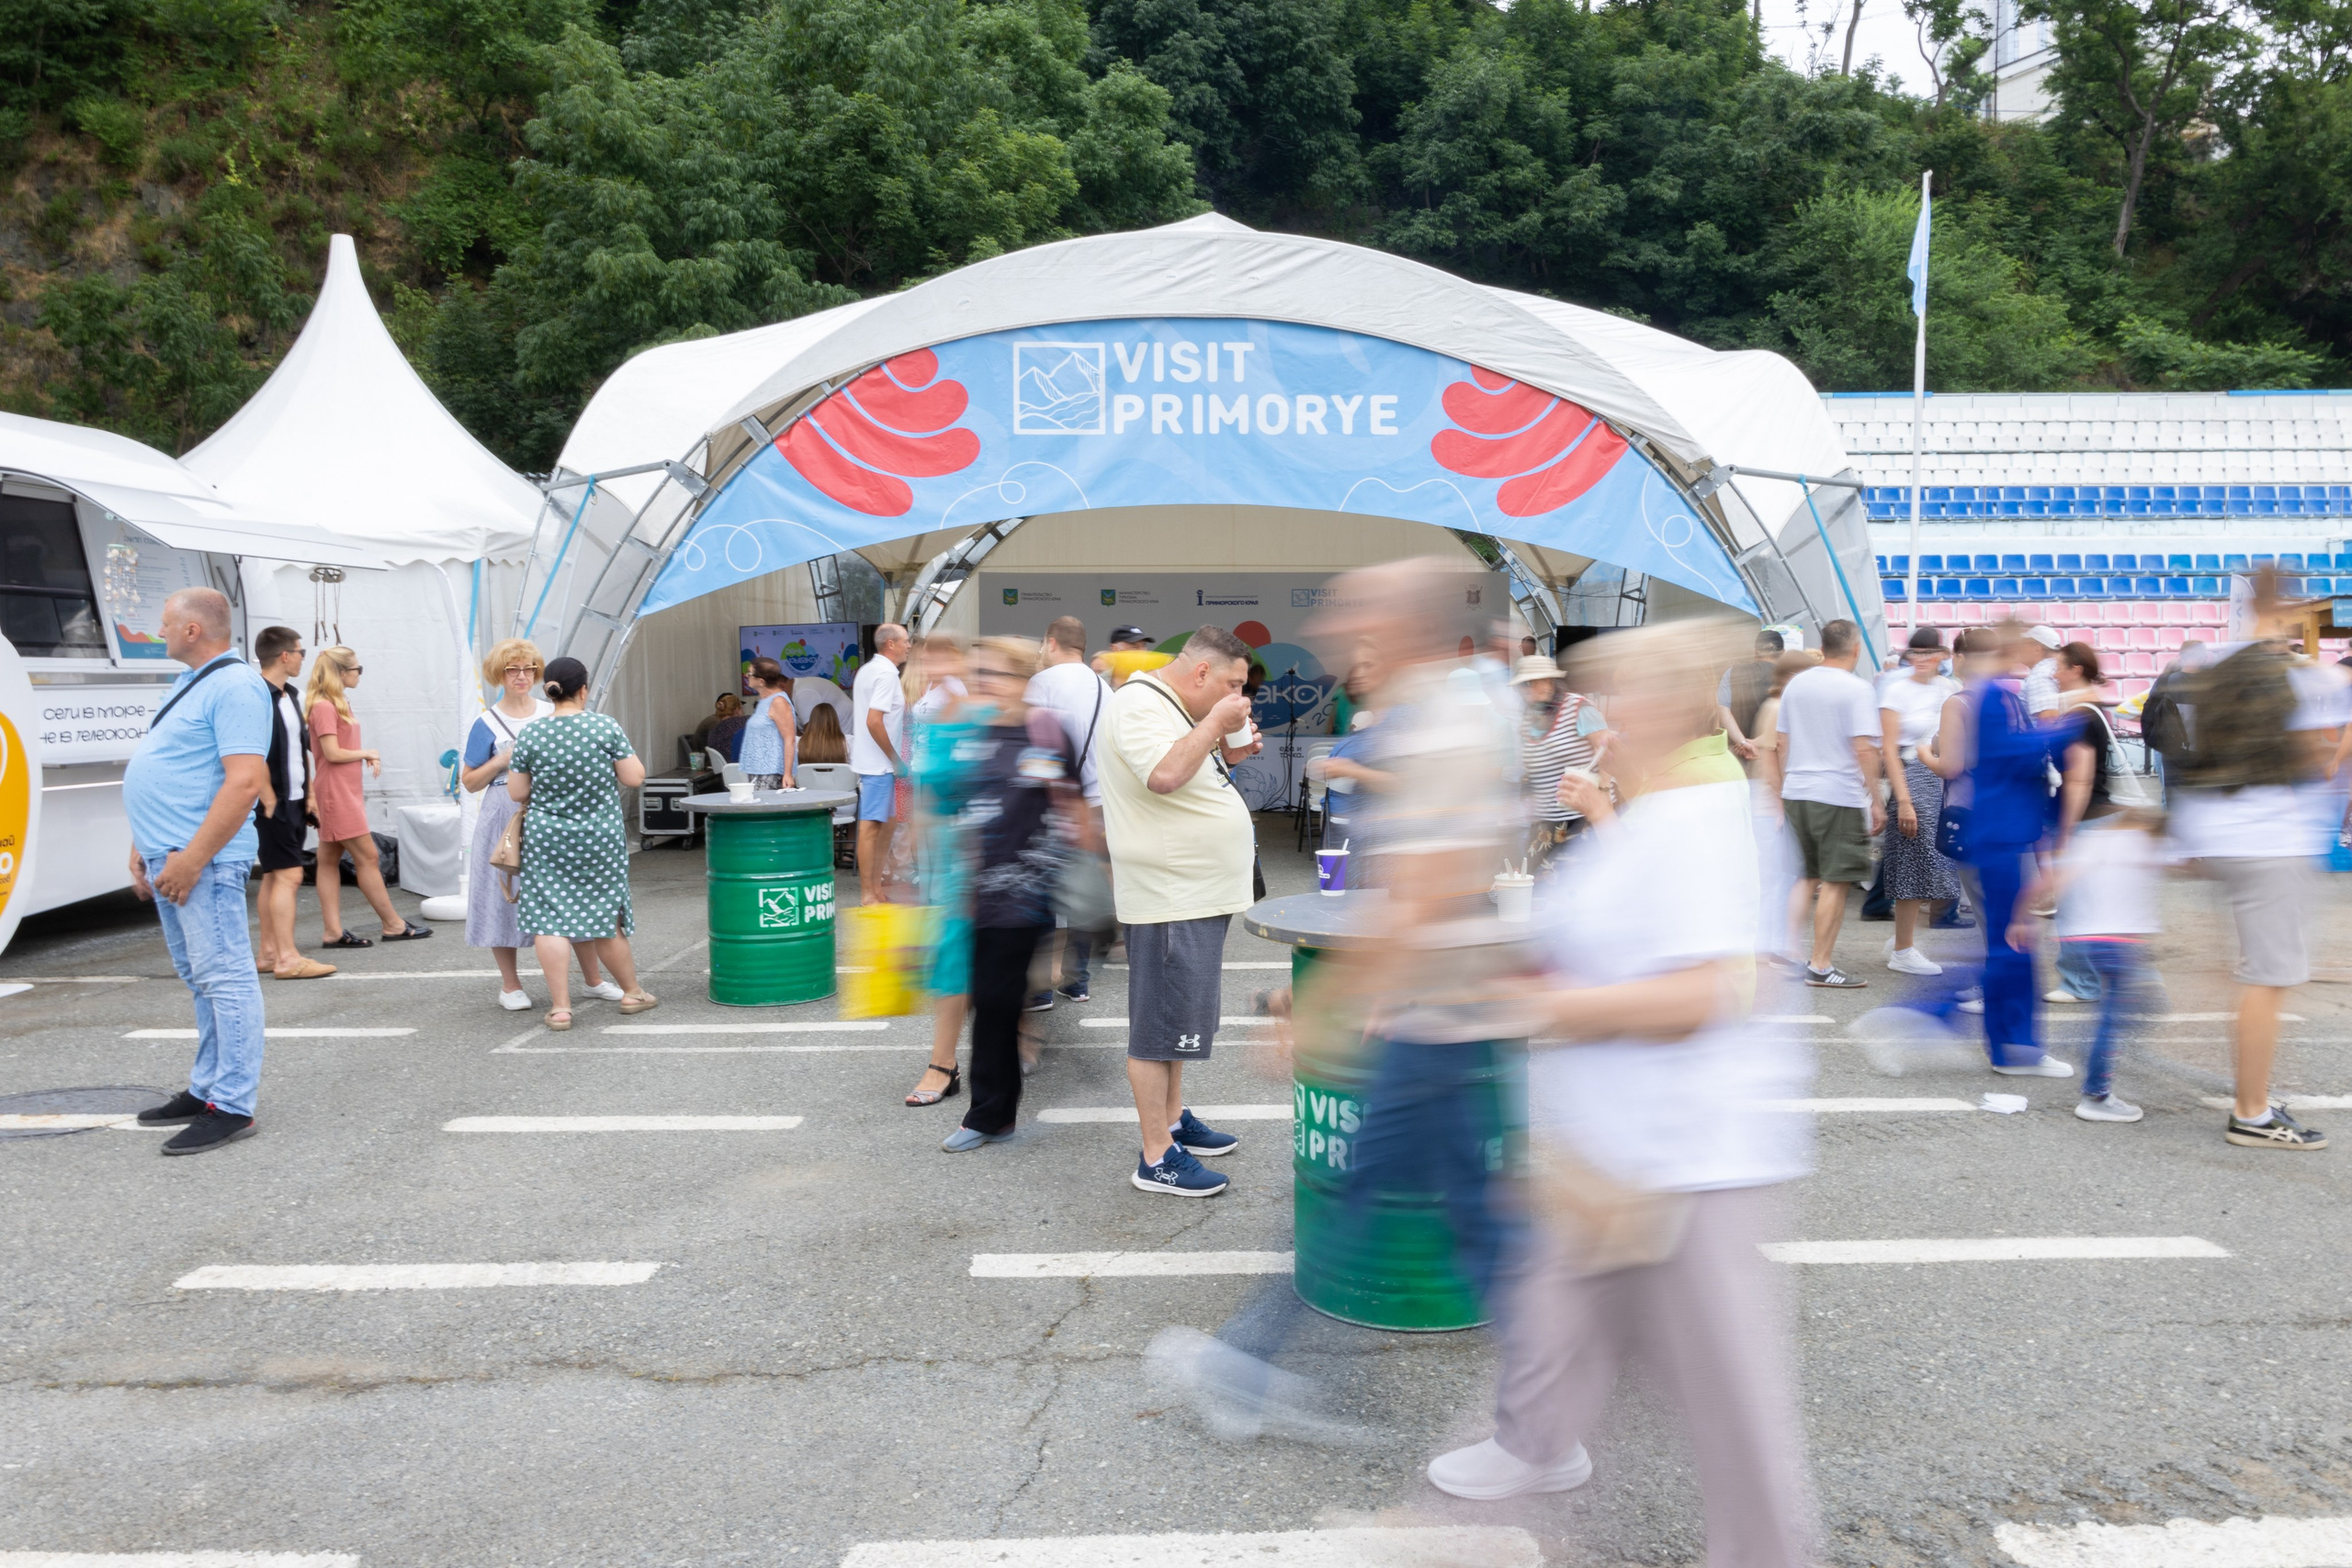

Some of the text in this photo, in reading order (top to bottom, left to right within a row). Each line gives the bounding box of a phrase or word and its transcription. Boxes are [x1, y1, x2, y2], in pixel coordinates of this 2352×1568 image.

[1113, 341, 1256, 383] VISIT
[1113, 394, 1399, 436] PRIMORYE
[1310, 588, 1339, 597] VISIT
[97, 705, 146, 719] море
